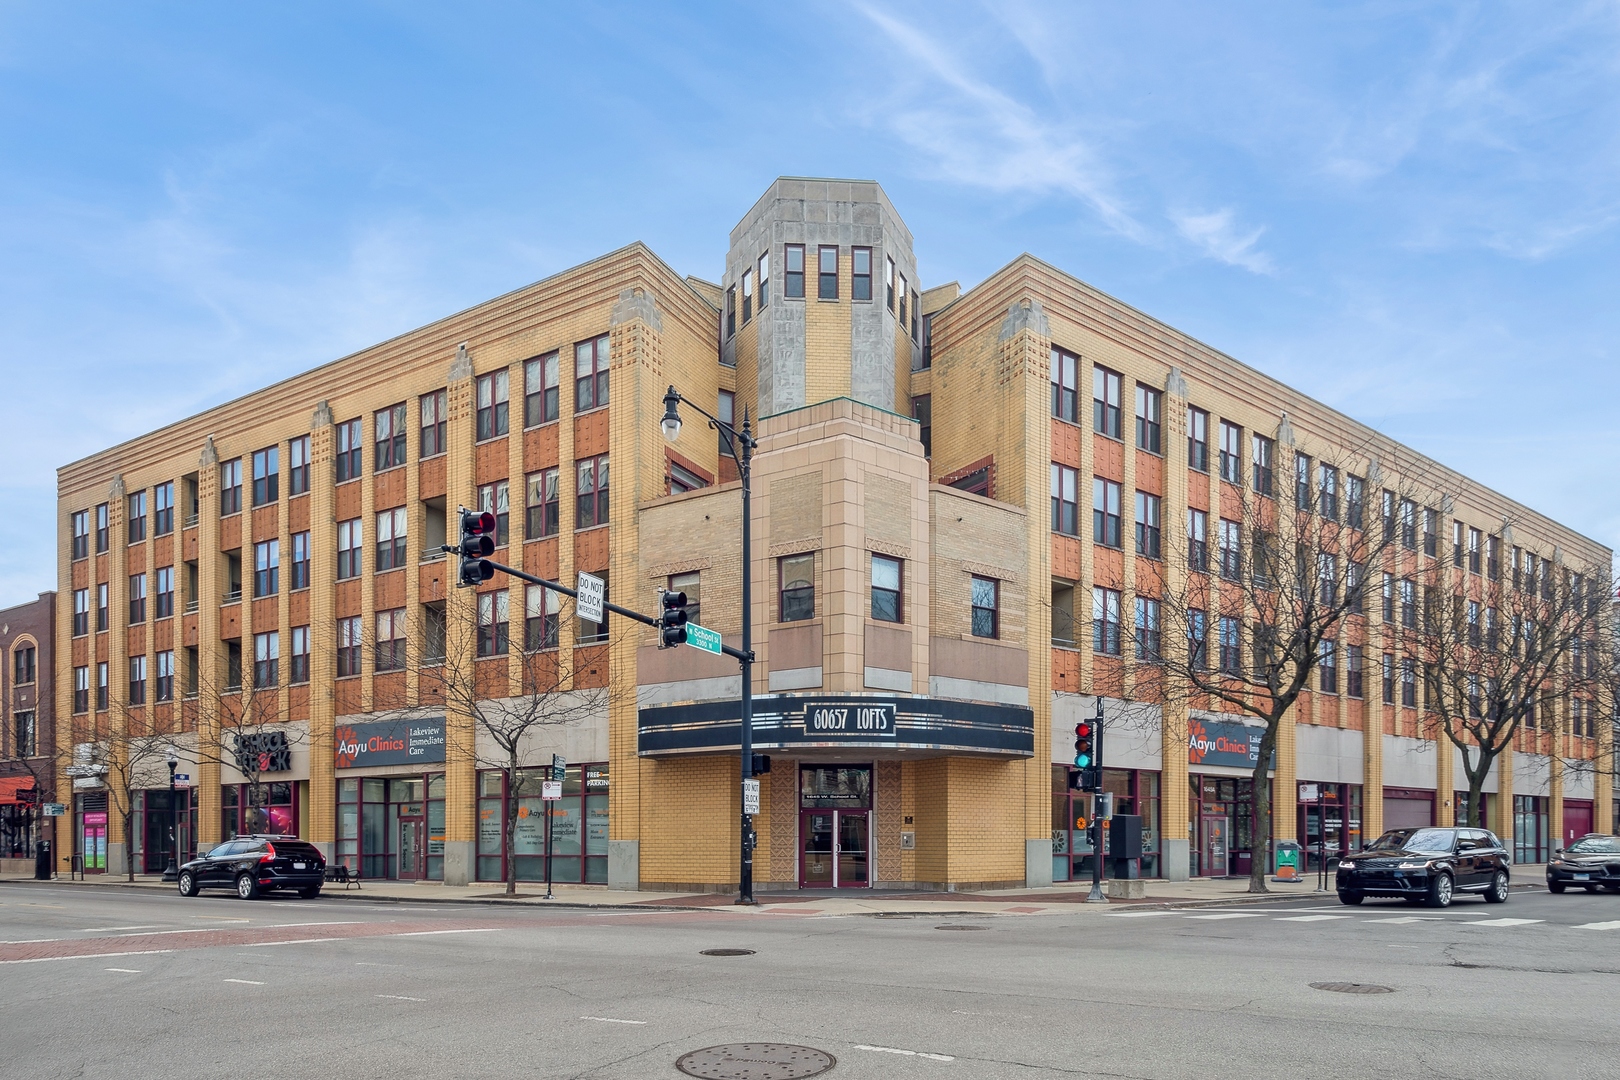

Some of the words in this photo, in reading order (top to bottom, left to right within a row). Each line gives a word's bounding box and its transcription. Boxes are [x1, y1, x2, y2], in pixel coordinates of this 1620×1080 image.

[580, 577, 589, 589] DO
[590, 581, 603, 594] NOT
[579, 592, 601, 608] BLOCK
[578, 605, 601, 618] INTERSECTION
[693, 627, 714, 643] School
[714, 636, 720, 645] St
[696, 639, 708, 648] 3300
[814, 708, 848, 730] 60657
[856, 708, 887, 730] LOFTS
[409, 726, 440, 736] Lakeview
[233, 731, 287, 754] SCHOOL
[338, 739, 367, 758] Aayu
[367, 735, 404, 752] Clinics
[409, 736, 444, 746] Immediate
[1189, 734, 1216, 755] Aayu
[1216, 736, 1247, 754] Clinics
[409, 746, 425, 756] Care
[1249, 753, 1259, 761] Car
[248, 750, 290, 771] ROCK
[745, 783, 751, 791] DO
[751, 784, 760, 792] NOT
[745, 794, 759, 803] BLOCK
[528, 810, 545, 819] Aayu
